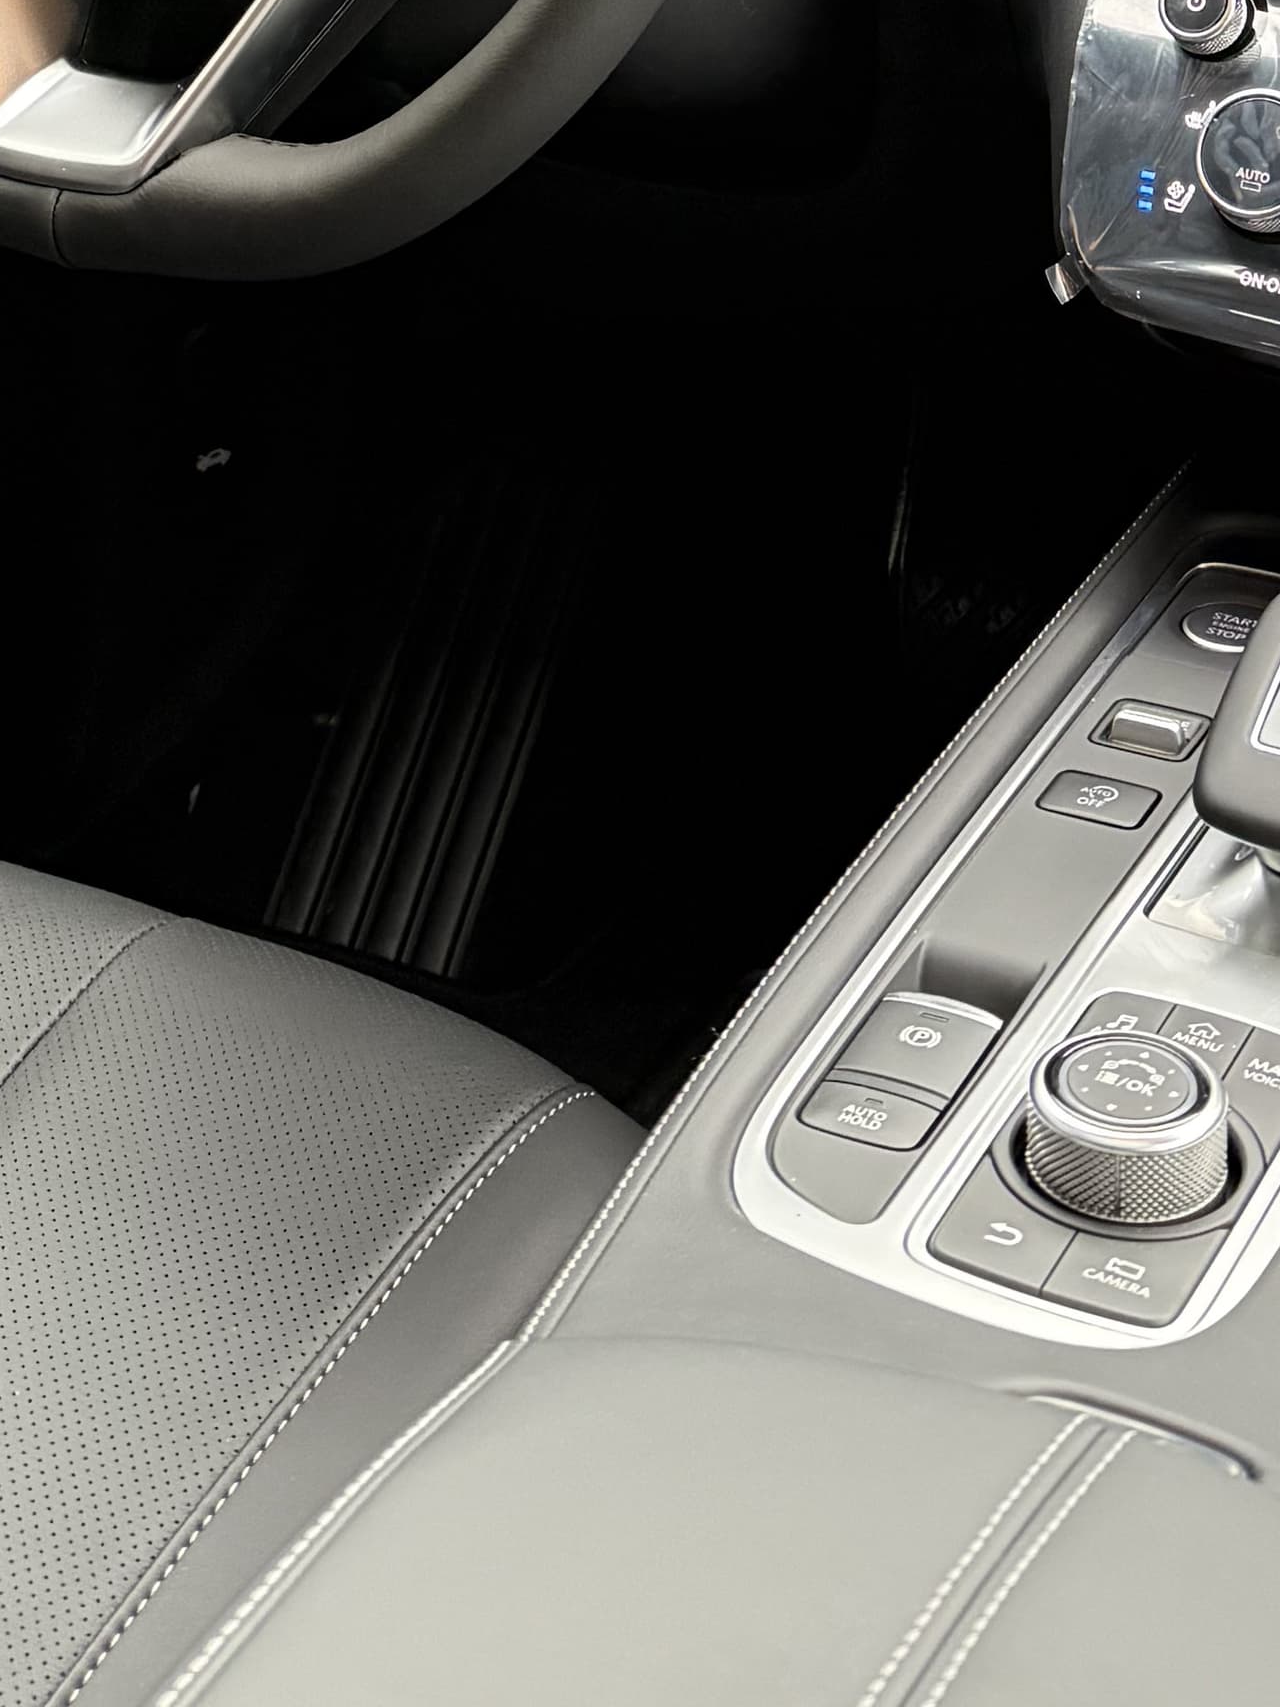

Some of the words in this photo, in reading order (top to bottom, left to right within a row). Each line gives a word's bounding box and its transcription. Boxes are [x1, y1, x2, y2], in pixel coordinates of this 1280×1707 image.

[1235, 167, 1270, 183] AUTO
[1213, 612, 1257, 628] START
[1206, 627, 1247, 640] STOP
[1077, 796, 1105, 807] OFF
[1172, 1032, 1224, 1053] MENU
[842, 1104, 888, 1121] AUTO
[837, 1112, 882, 1130] HOLD
[1081, 1267, 1150, 1299] CAMERA
